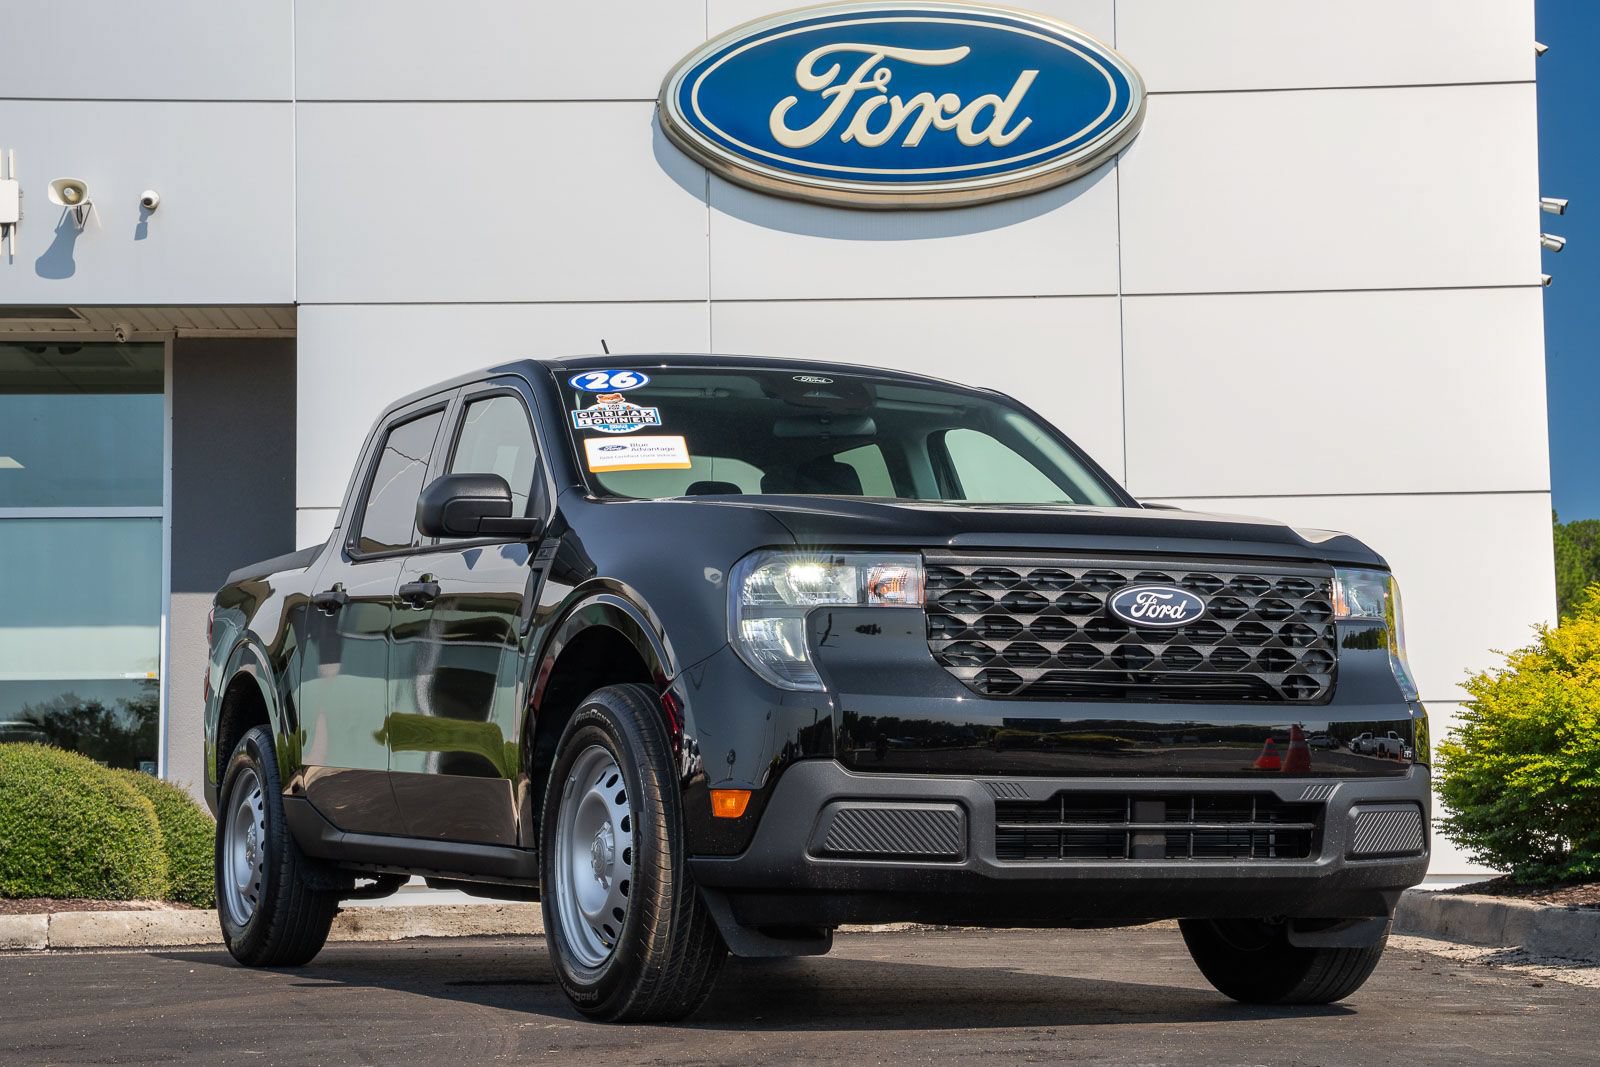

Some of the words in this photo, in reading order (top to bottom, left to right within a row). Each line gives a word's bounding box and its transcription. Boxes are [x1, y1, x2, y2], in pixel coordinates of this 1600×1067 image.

[769, 43, 1040, 149] Ford
[585, 372, 638, 389] 26
[593, 417, 655, 425] OWNER
[1131, 592, 1187, 618] Ford
